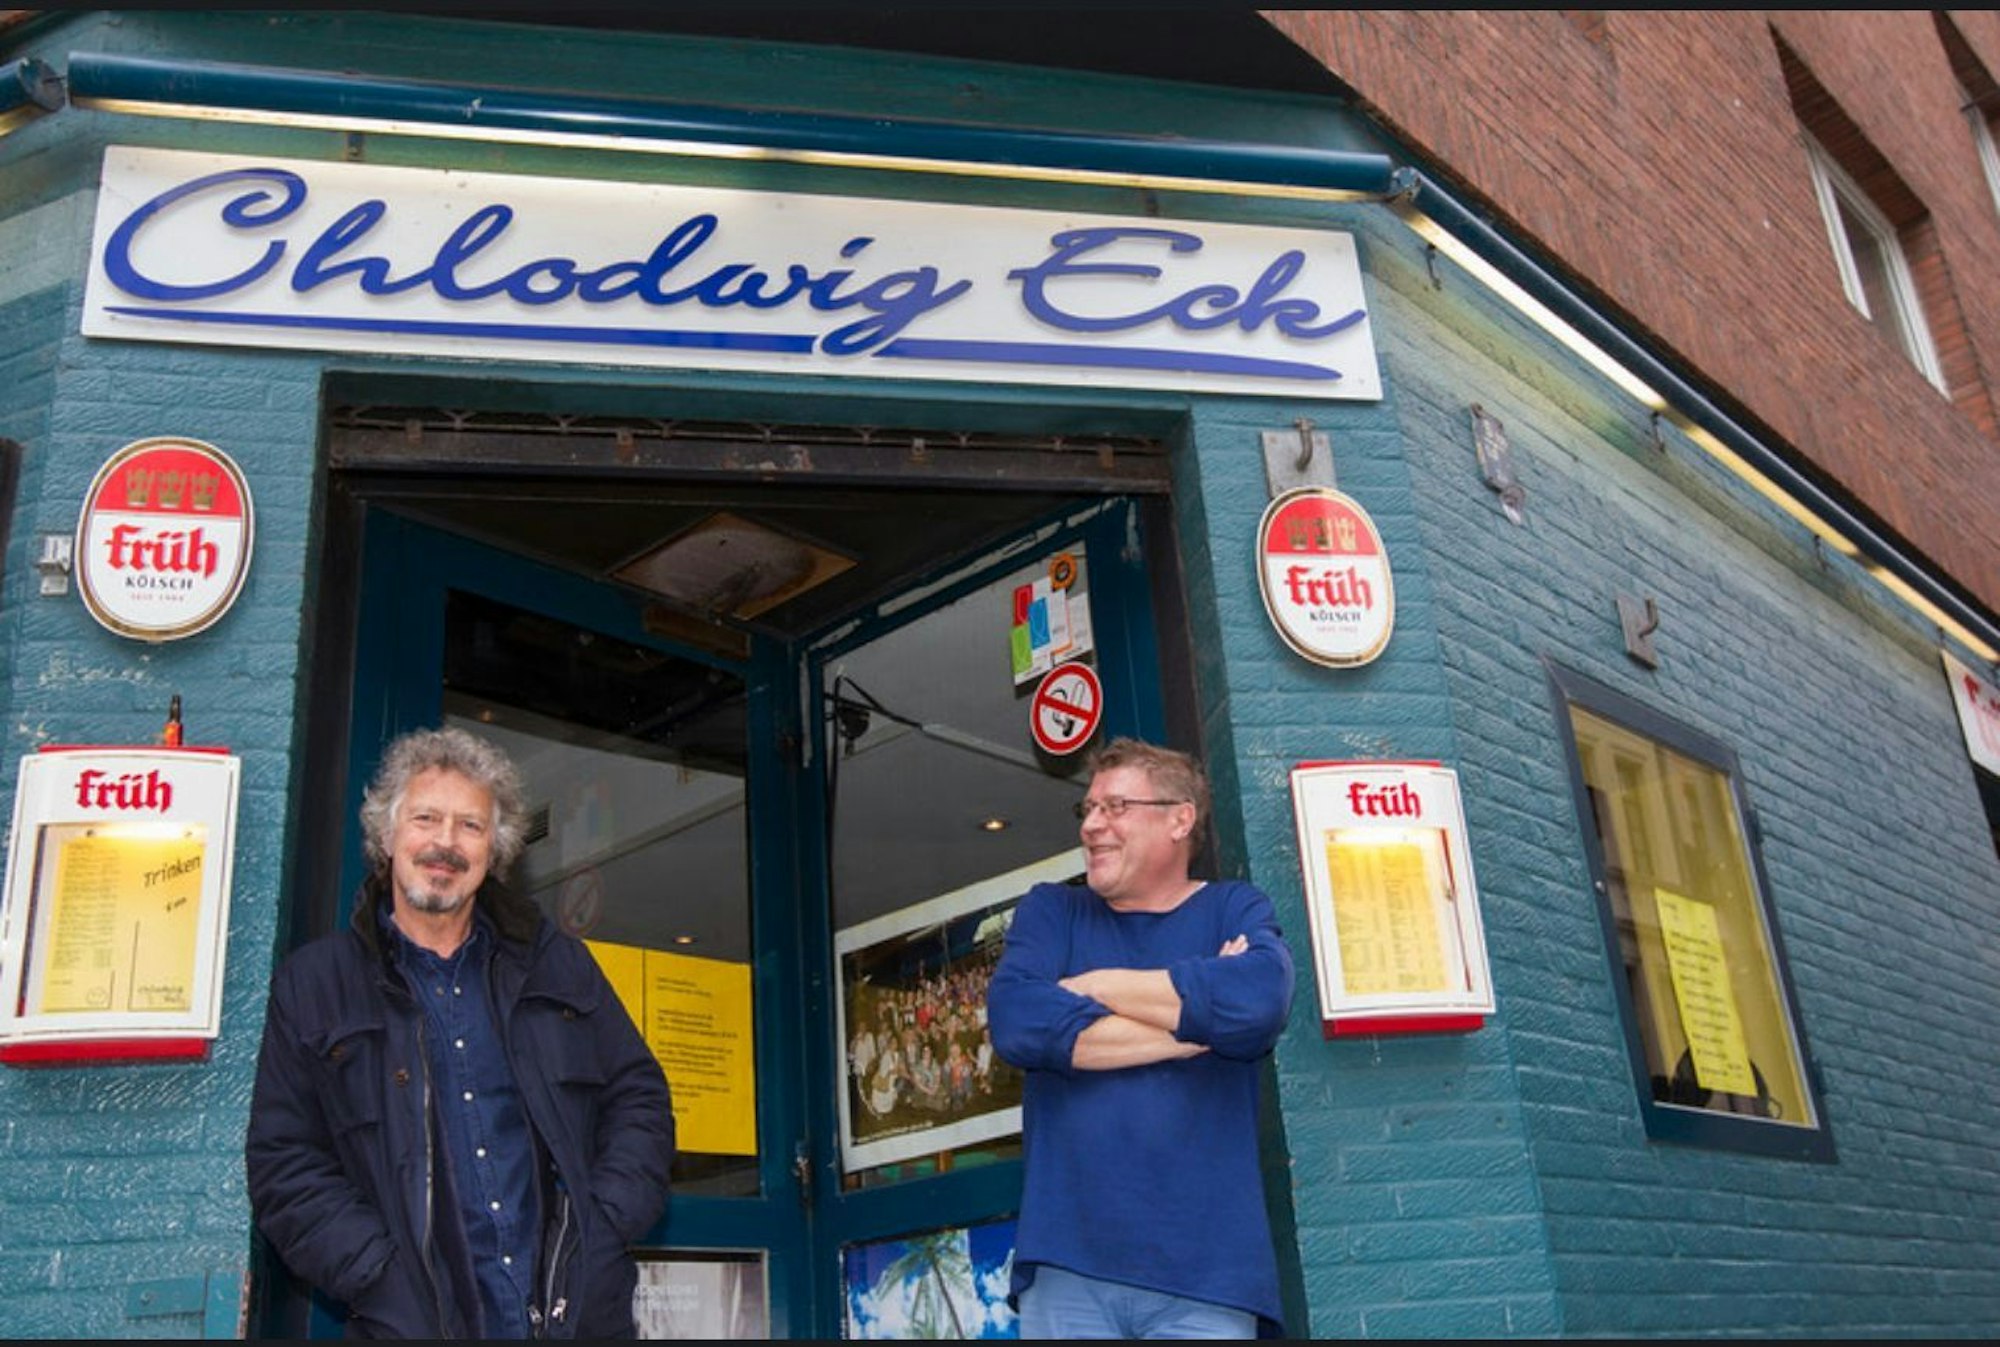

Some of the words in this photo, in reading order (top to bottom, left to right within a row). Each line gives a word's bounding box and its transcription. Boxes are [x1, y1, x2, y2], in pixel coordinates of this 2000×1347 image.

[103, 167, 972, 355] Chlodwig
[1007, 226, 1365, 340] Eck
[125, 575, 194, 591] KÖLSCH
[1309, 609, 1361, 622] KÖLSCH
[143, 855, 202, 888] Trinken
